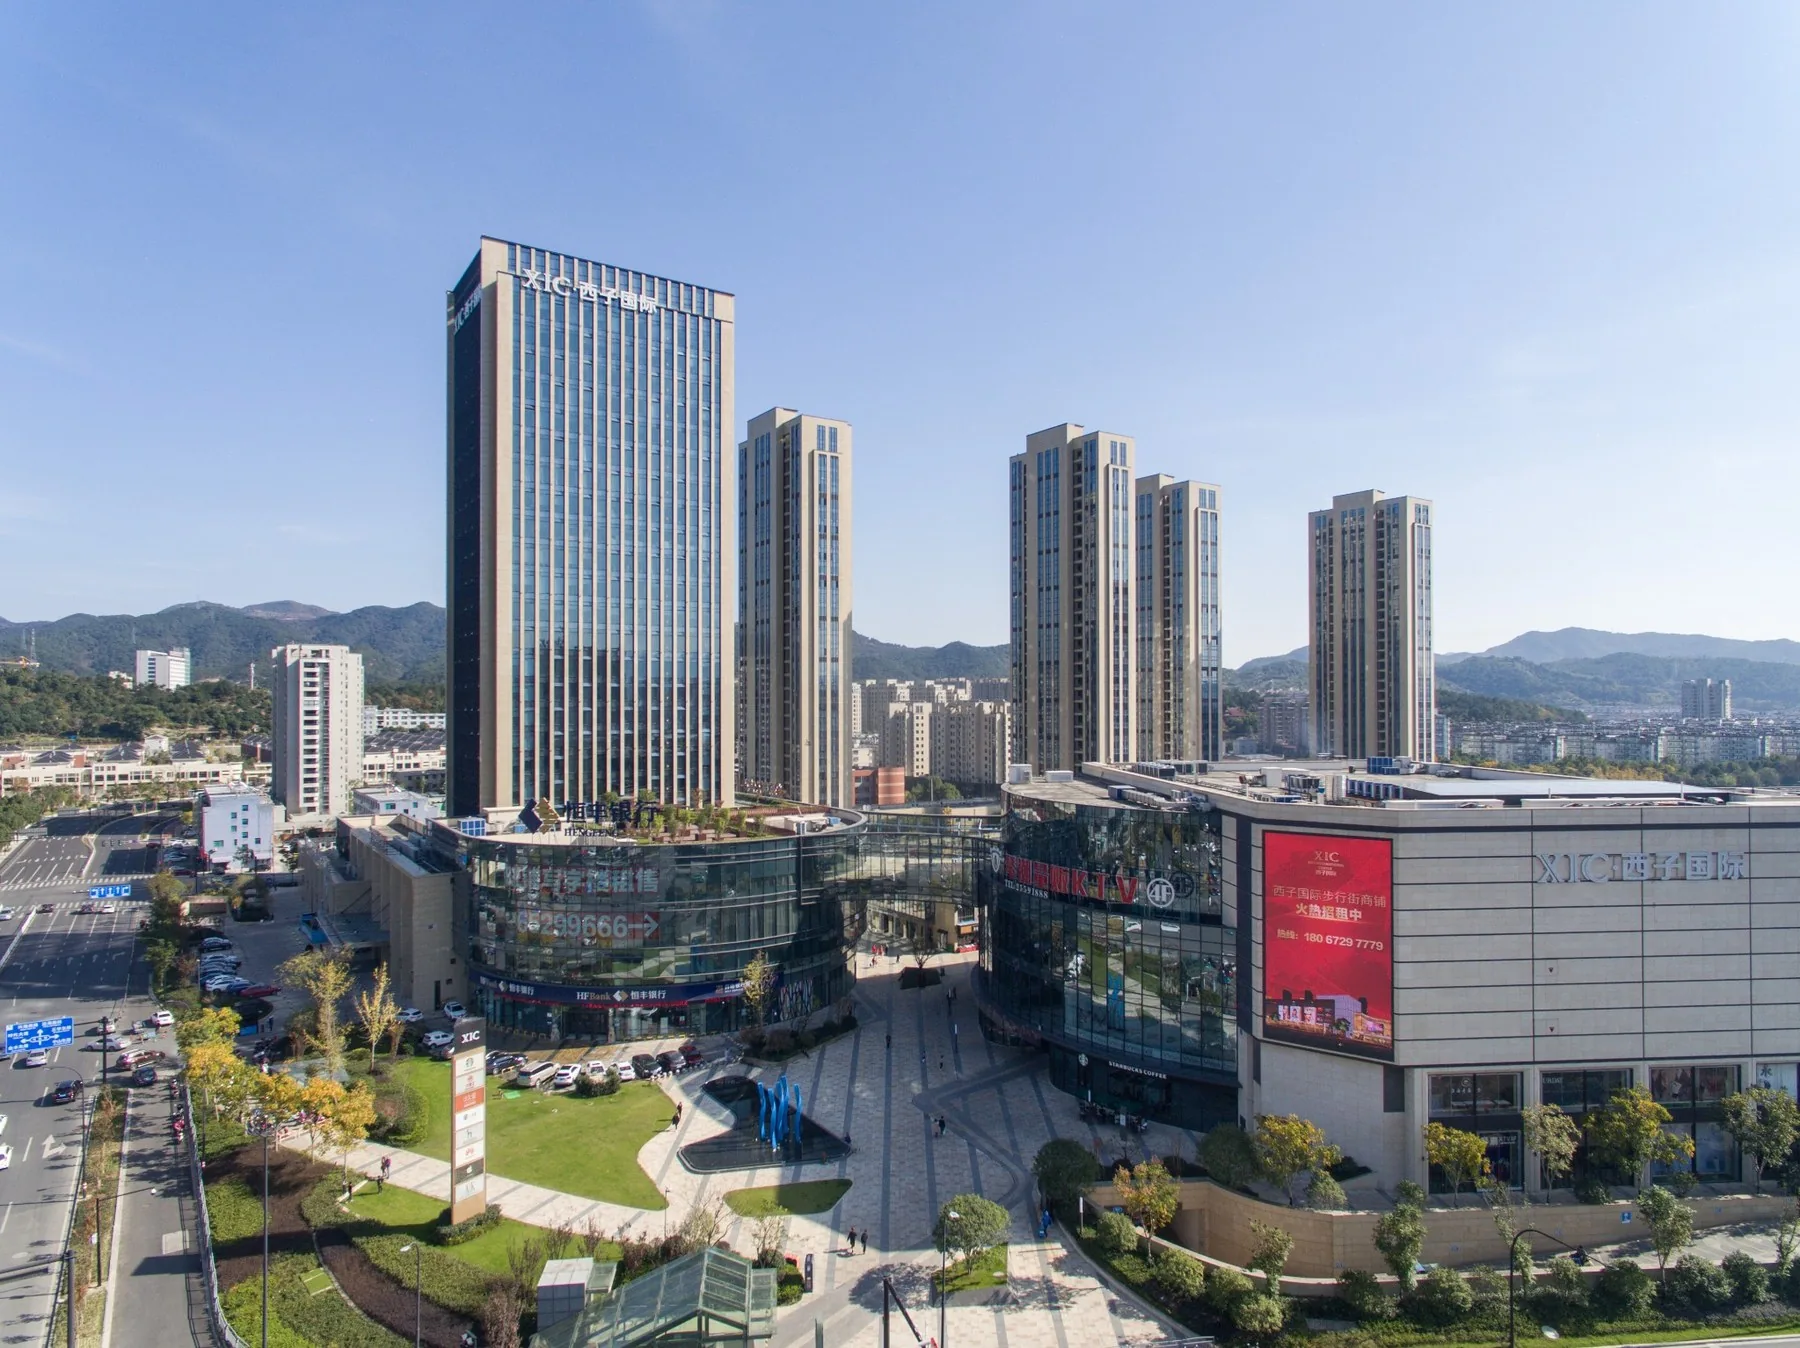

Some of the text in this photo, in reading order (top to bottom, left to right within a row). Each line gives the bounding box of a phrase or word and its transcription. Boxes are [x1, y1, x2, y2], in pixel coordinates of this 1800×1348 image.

[1315, 851, 1340, 863] XIC
[1273, 885, 1386, 908] 西子国际步行街商铺
[1295, 902, 1362, 921] 火热招租中
[1304, 932, 1323, 943] 180
[1325, 935, 1353, 947] 6729
[1356, 939, 1384, 951] 7779
[576, 990, 667, 1001] HFBank 恒丰银行
[461, 1031, 480, 1043] XIC
[1108, 1061, 1167, 1080] STARBUCKS COFFEE
